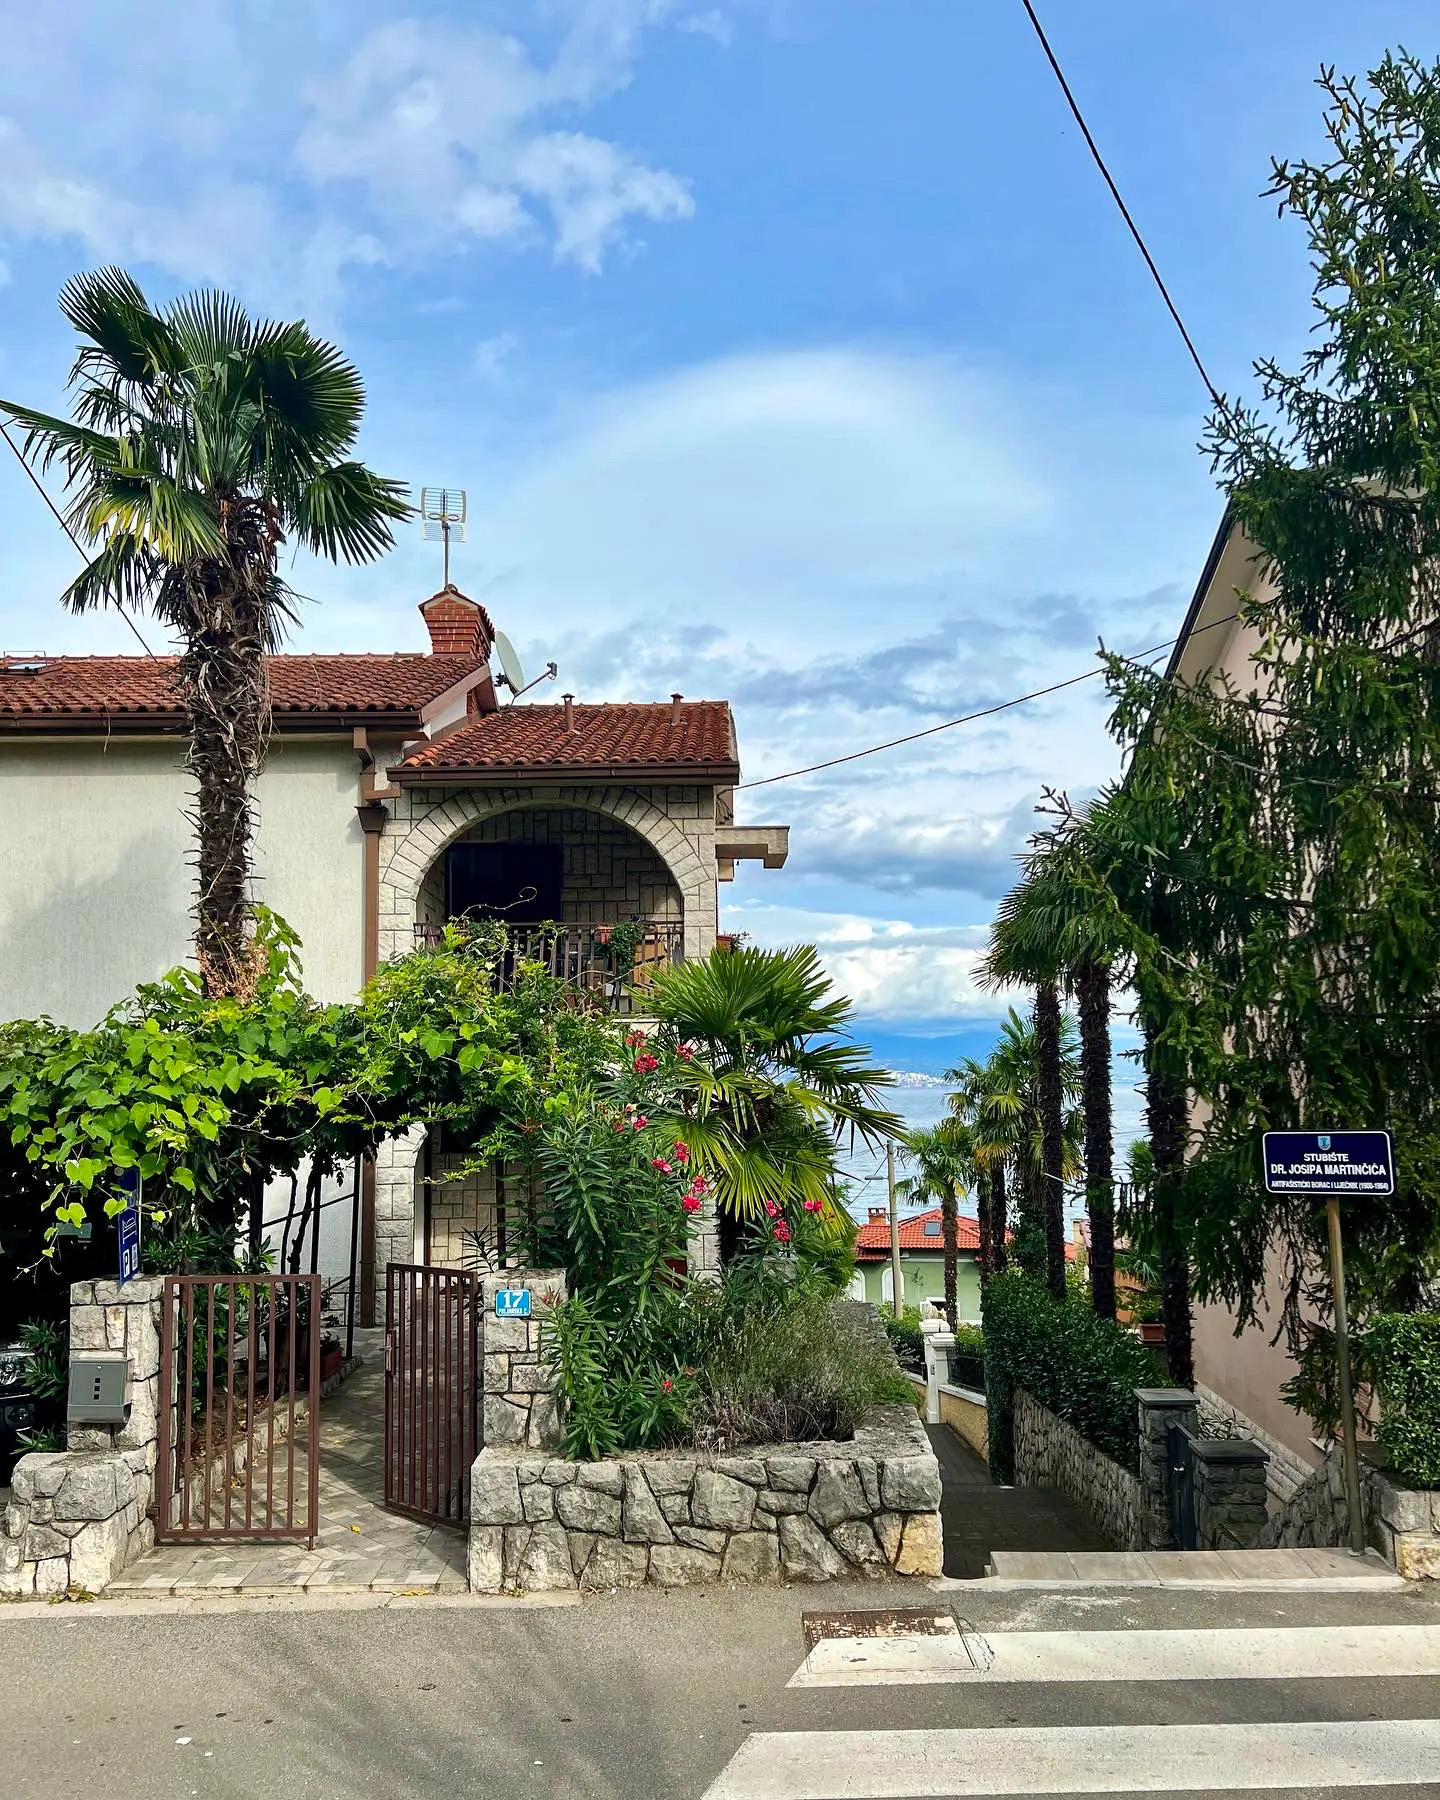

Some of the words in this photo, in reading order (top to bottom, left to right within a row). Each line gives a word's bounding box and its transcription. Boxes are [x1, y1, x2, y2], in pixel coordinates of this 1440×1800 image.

[1303, 1152, 1349, 1162] STUBIŠTE
[1270, 1163, 1287, 1174] DR.
[1288, 1164, 1323, 1175] JOSIPA
[1324, 1163, 1387, 1176] MARTINČIĆA
[1311, 1181, 1331, 1189] BORAC
[504, 1292, 524, 1308] 17
